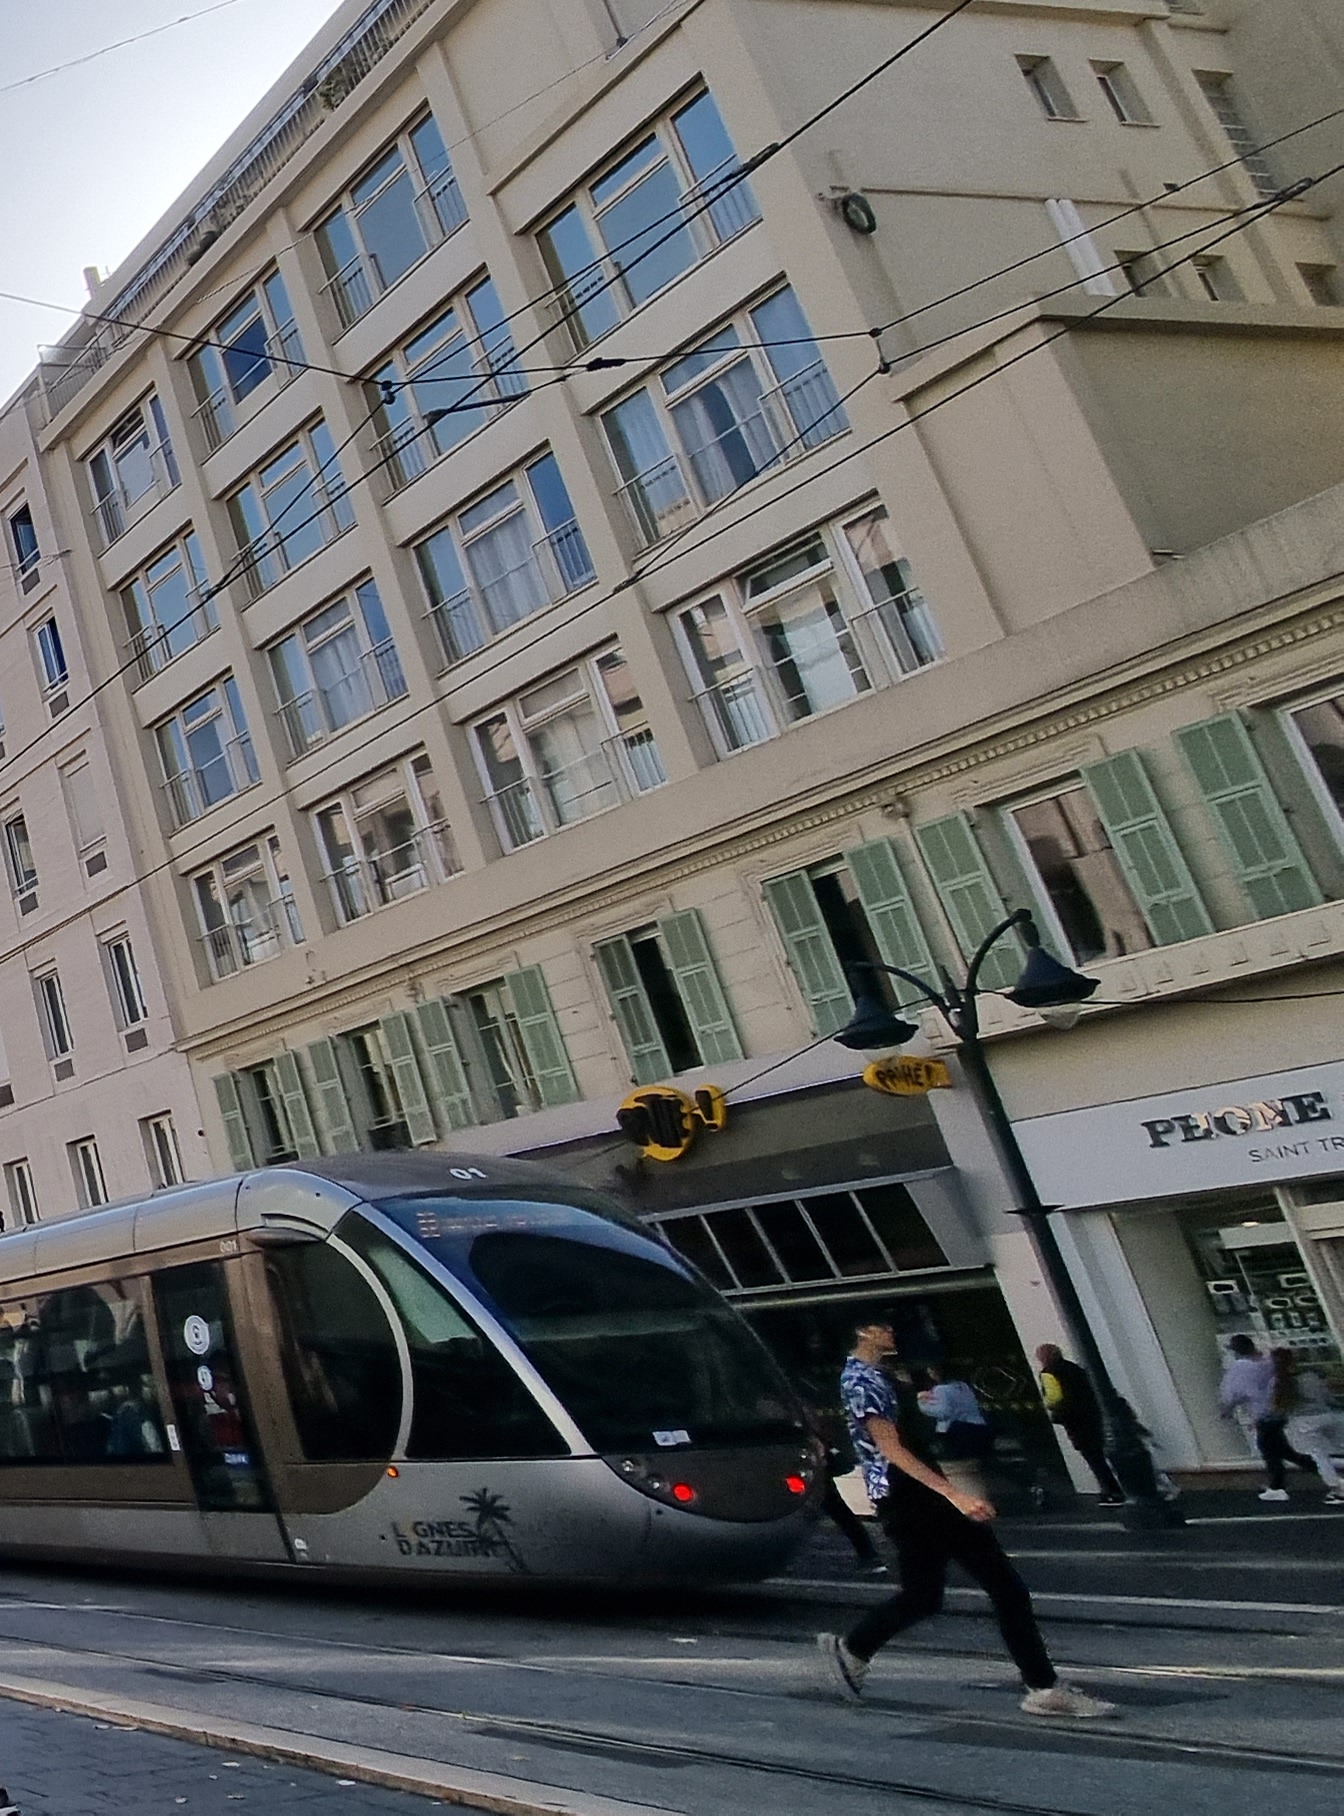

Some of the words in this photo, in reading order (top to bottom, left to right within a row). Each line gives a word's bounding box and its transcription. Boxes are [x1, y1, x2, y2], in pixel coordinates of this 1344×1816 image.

[1141, 1091, 1332, 1149] PEONE
[1249, 1142, 1310, 1163] SAINT
[449, 1167, 488, 1181] 01
[392, 1520, 477, 1540] LGNES
